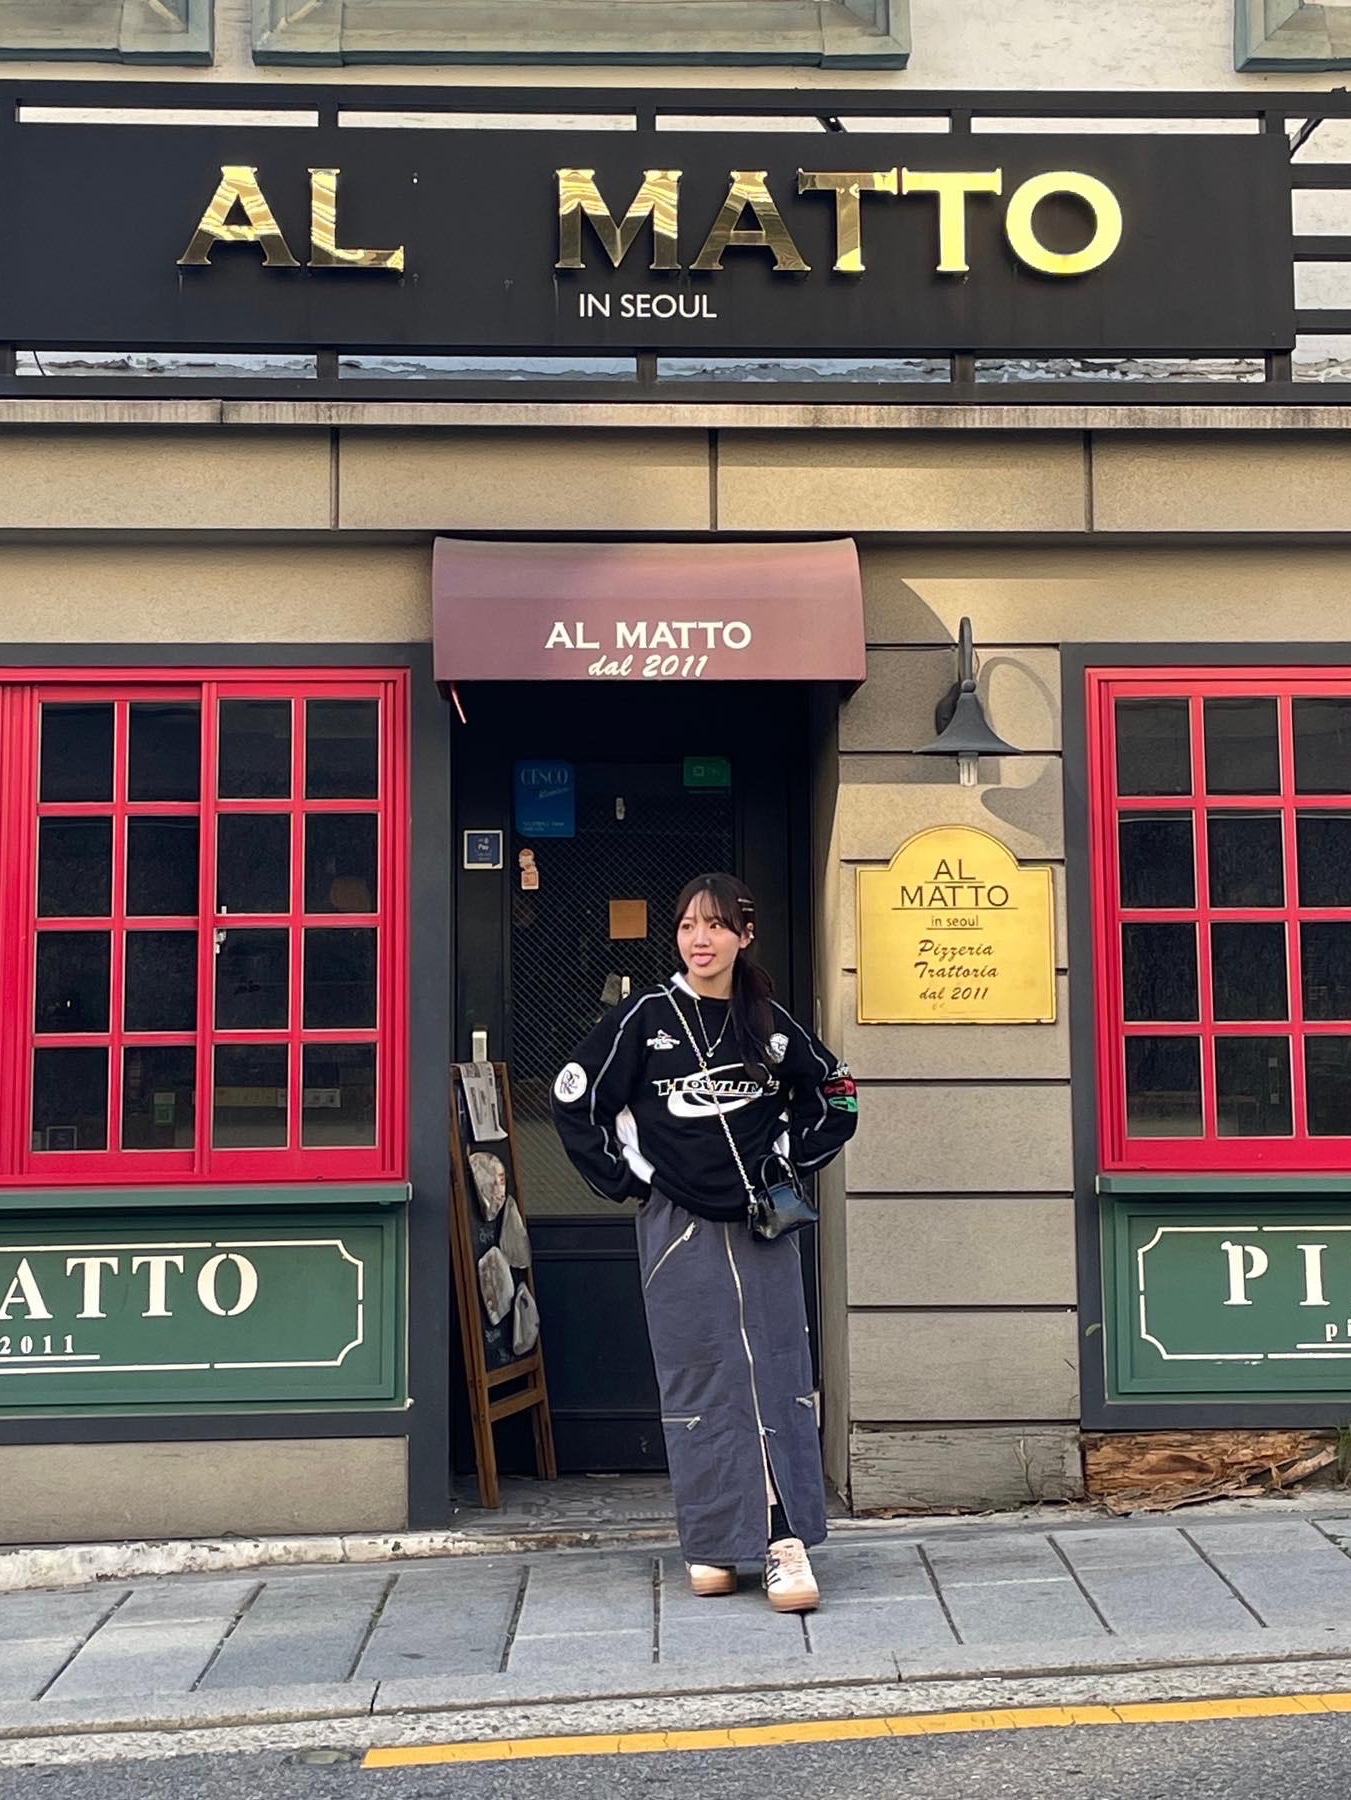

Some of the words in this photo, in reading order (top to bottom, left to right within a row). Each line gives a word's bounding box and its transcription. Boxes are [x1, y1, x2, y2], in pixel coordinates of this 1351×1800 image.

[176, 165, 405, 272] AL
[552, 166, 1124, 277] MATTO
[578, 294, 611, 318] IN
[619, 293, 718, 319] SEOUL
[544, 621, 600, 650] AL
[615, 621, 753, 650] MATTO
[587, 654, 633, 677] dal
[642, 654, 709, 678] 2011
[933, 859, 976, 881] AL
[901, 885, 1009, 907] MATTO
[930, 915, 942, 927] in
[946, 915, 979, 927] seoul
[918, 939, 994, 961] Pizzeria
[913, 961, 999, 979] Trattoria
[919, 986, 945, 1000] dal
[950, 986, 989, 1000] 2011
[0, 1333, 75, 1355] 2011
